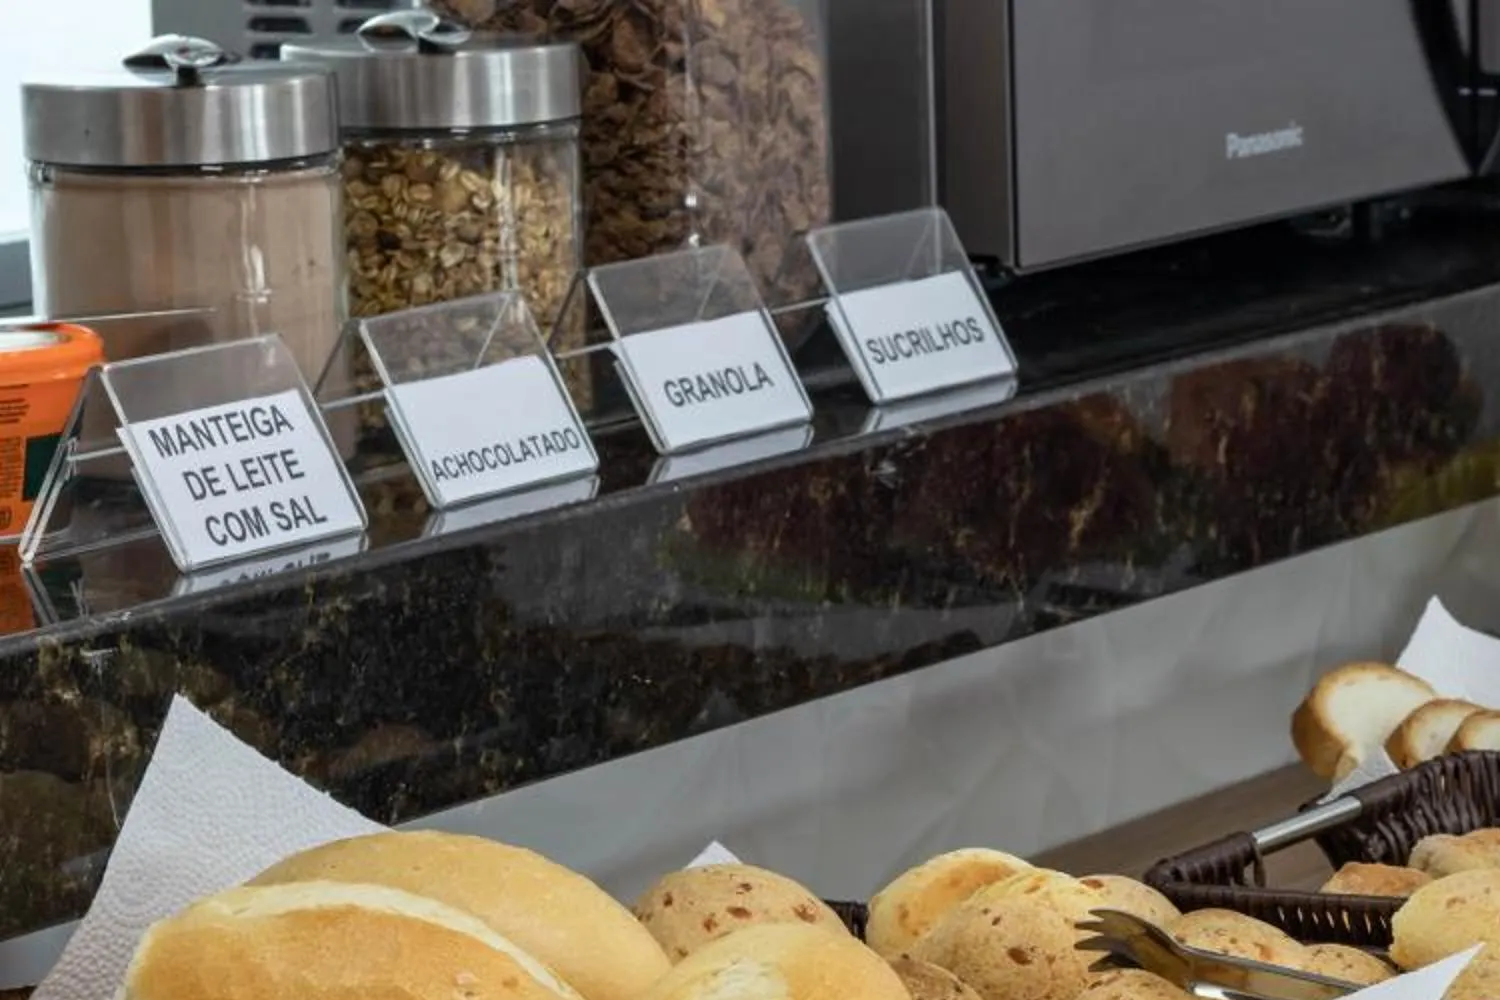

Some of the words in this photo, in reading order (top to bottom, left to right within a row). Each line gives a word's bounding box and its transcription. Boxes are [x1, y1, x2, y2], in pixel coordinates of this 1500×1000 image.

[1226, 120, 1303, 159] Panasonic
[866, 316, 985, 364] SUCRILHOS
[663, 361, 774, 408] GRANOLA
[149, 404, 295, 458] MANTEIGA
[432, 427, 580, 481] ACHOCOLATADO
[183, 464, 226, 501] DE
[233, 447, 305, 491] LEITE
[205, 502, 271, 547] COM
[271, 495, 328, 536] SAL
